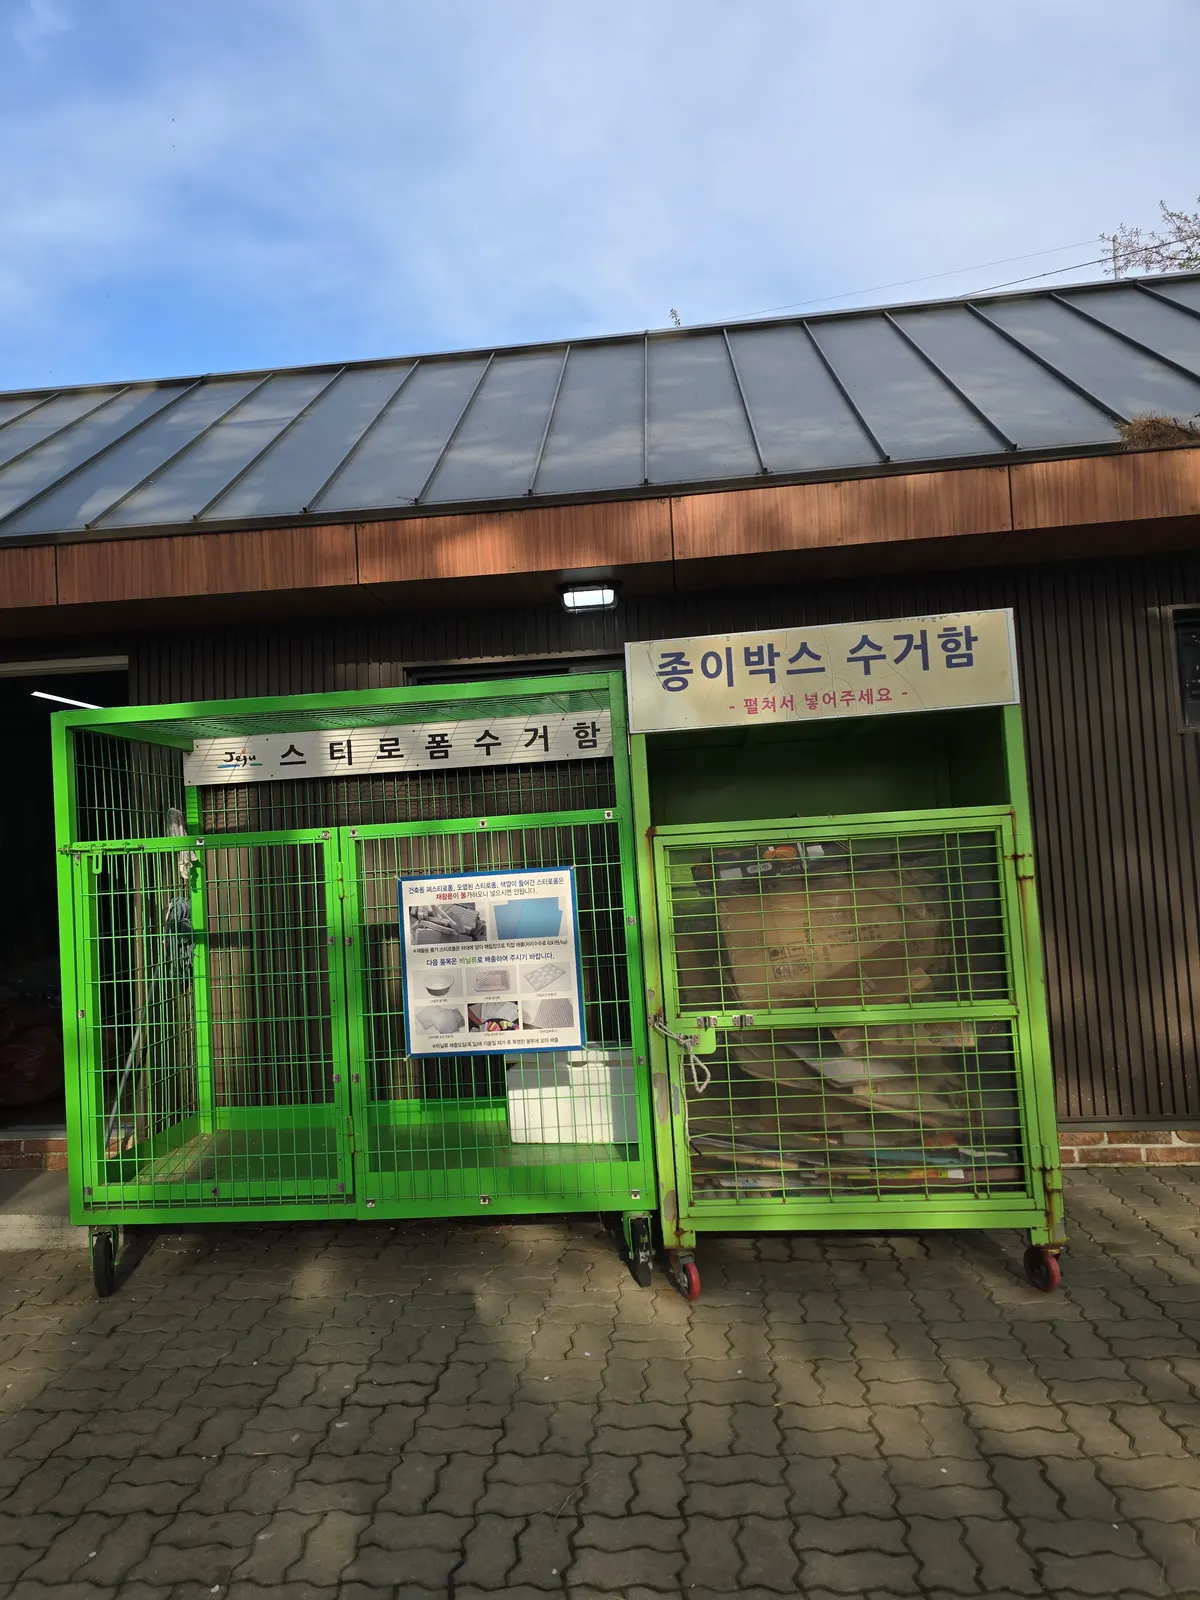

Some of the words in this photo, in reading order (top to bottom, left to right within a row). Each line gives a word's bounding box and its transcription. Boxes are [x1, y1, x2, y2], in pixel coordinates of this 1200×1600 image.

[657, 642, 826, 693] 종이박스
[846, 625, 979, 676] 수거함
[743, 695, 796, 716] 펼쳐서
[804, 687, 893, 710] 넣어주세요
[222, 750, 257, 767] Jeju
[456, 883, 473, 891] 오염된
[518, 879, 535, 887] 들어간
[536, 877, 564, 886] 스티로폼은
[435, 892, 458, 900] 재활용이
[460, 890, 488, 898] 불가하오니
[426, 958, 438, 966] 다음
[439, 957, 457, 965] 품목은
[484, 954, 507, 963] 배출하여
[509, 953, 527, 961] 주시기
[528, 951, 554, 960] 바랍니다.
